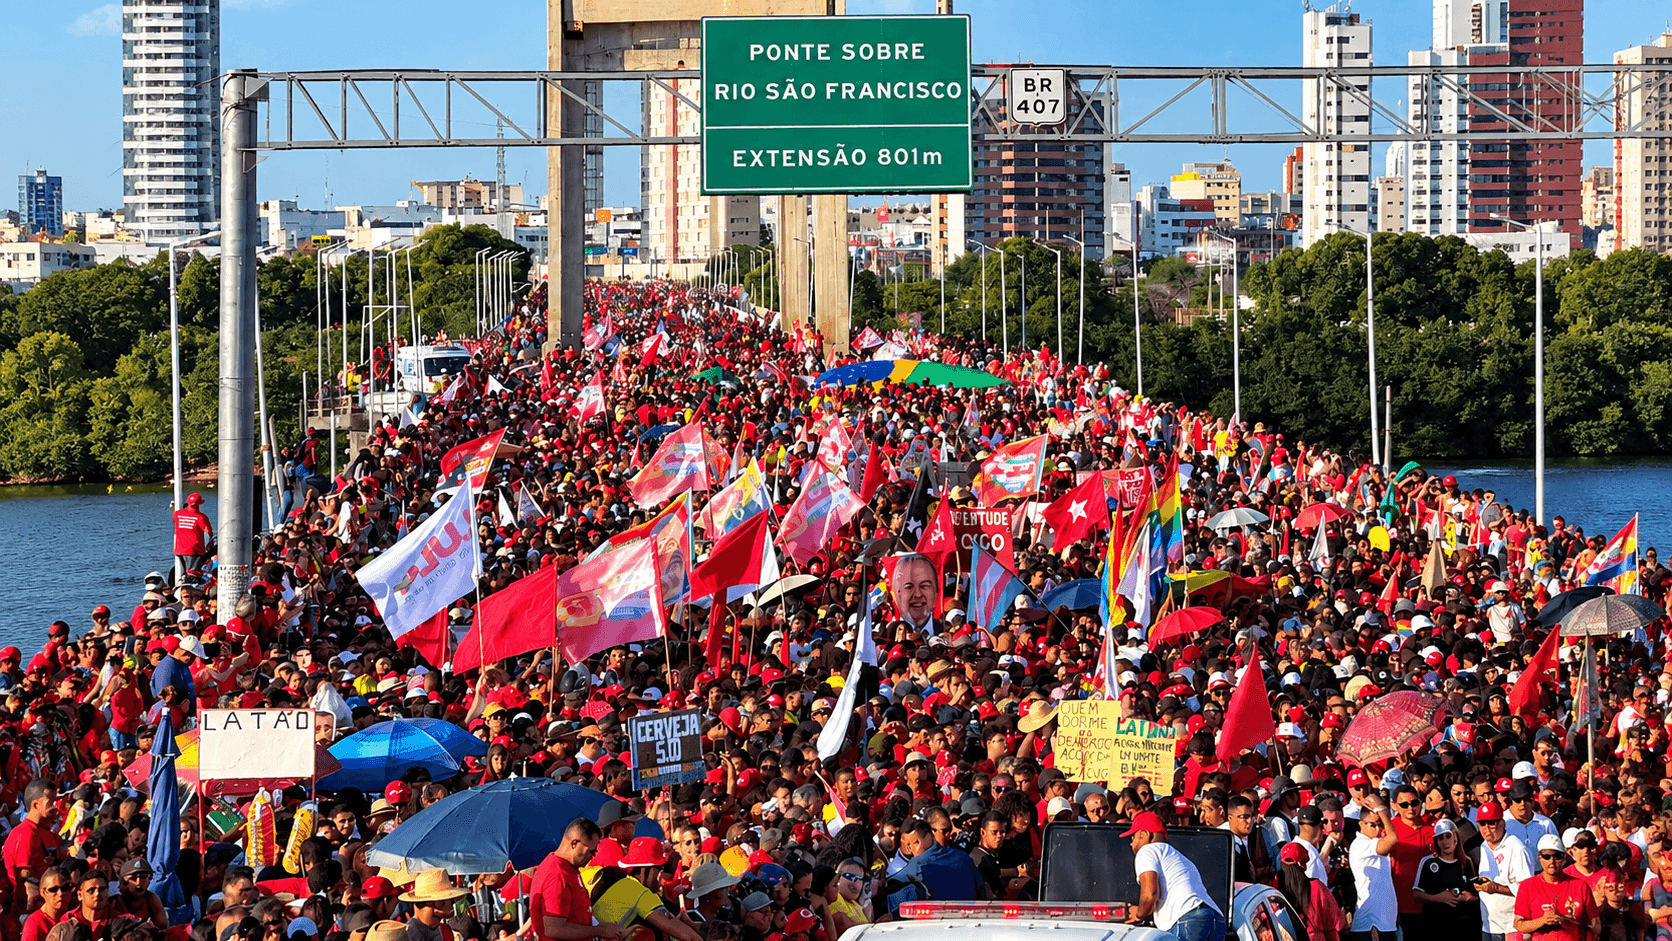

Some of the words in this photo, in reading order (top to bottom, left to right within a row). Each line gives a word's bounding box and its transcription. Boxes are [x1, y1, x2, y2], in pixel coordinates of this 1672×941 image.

[749, 44, 831, 61] PONTE
[841, 43, 925, 60] SOBRE
[714, 83, 756, 100] RIO
[765, 78, 816, 100] SÃO
[825, 82, 962, 99] FRANCISCO
[1023, 77, 1053, 93] BR
[1016, 99, 1061, 115] 407
[733, 143, 867, 167] EXTENSÃO
[877, 147, 943, 166] 801m
[637, 714, 700, 742] CERVEJA
